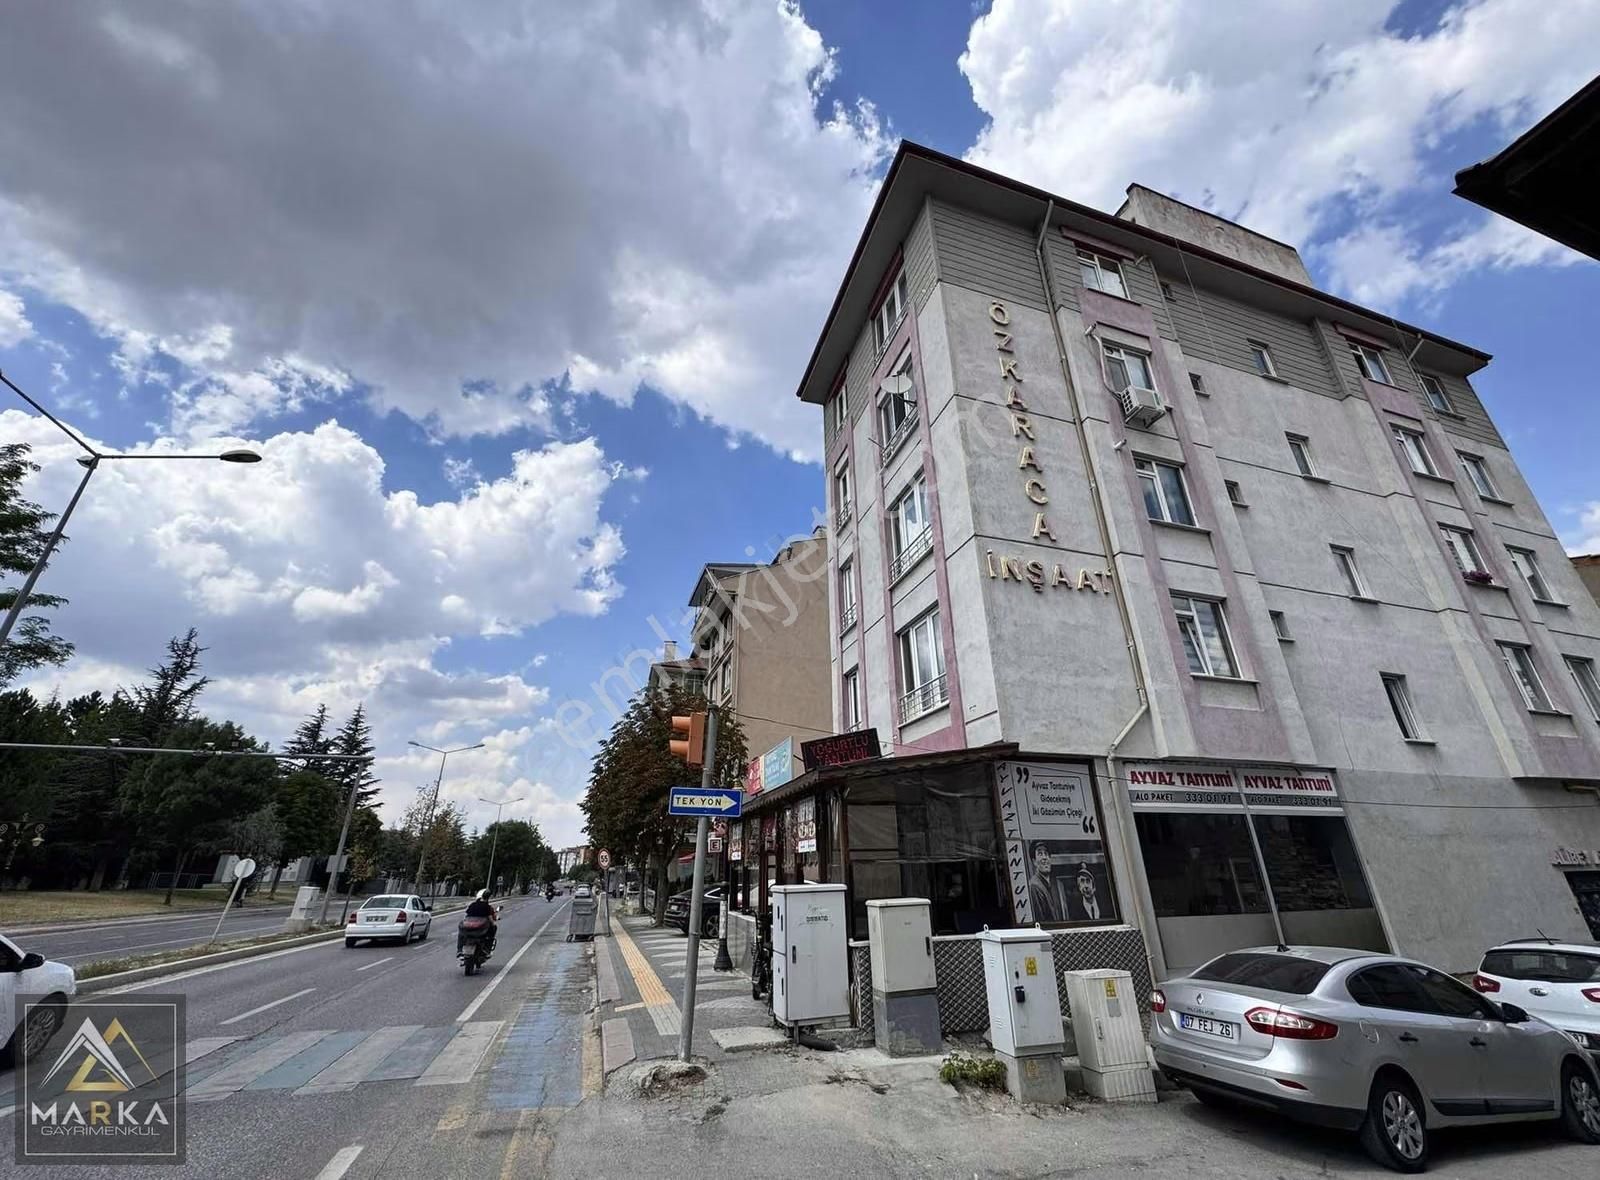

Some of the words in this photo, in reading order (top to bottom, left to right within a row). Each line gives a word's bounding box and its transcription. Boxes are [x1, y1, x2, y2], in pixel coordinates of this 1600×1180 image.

[988, 300, 1057, 542] ÖZKARACA
[986, 549, 1112, 594] İNŞAAT
[1130, 770, 1176, 786] AYVAZ
[1243, 775, 1284, 789] AYVAZ
[1031, 781, 1048, 792] Ayvaz
[675, 796, 696, 805] TEK
[1135, 793, 1149, 801] ALO
[1151, 793, 1174, 802] PAKET
[1185, 793, 1203, 803] 333
[1184, 1016, 1194, 1028] 07
[1198, 1019, 1214, 1032] FEJ
[1219, 1023, 1231, 1036] 26
